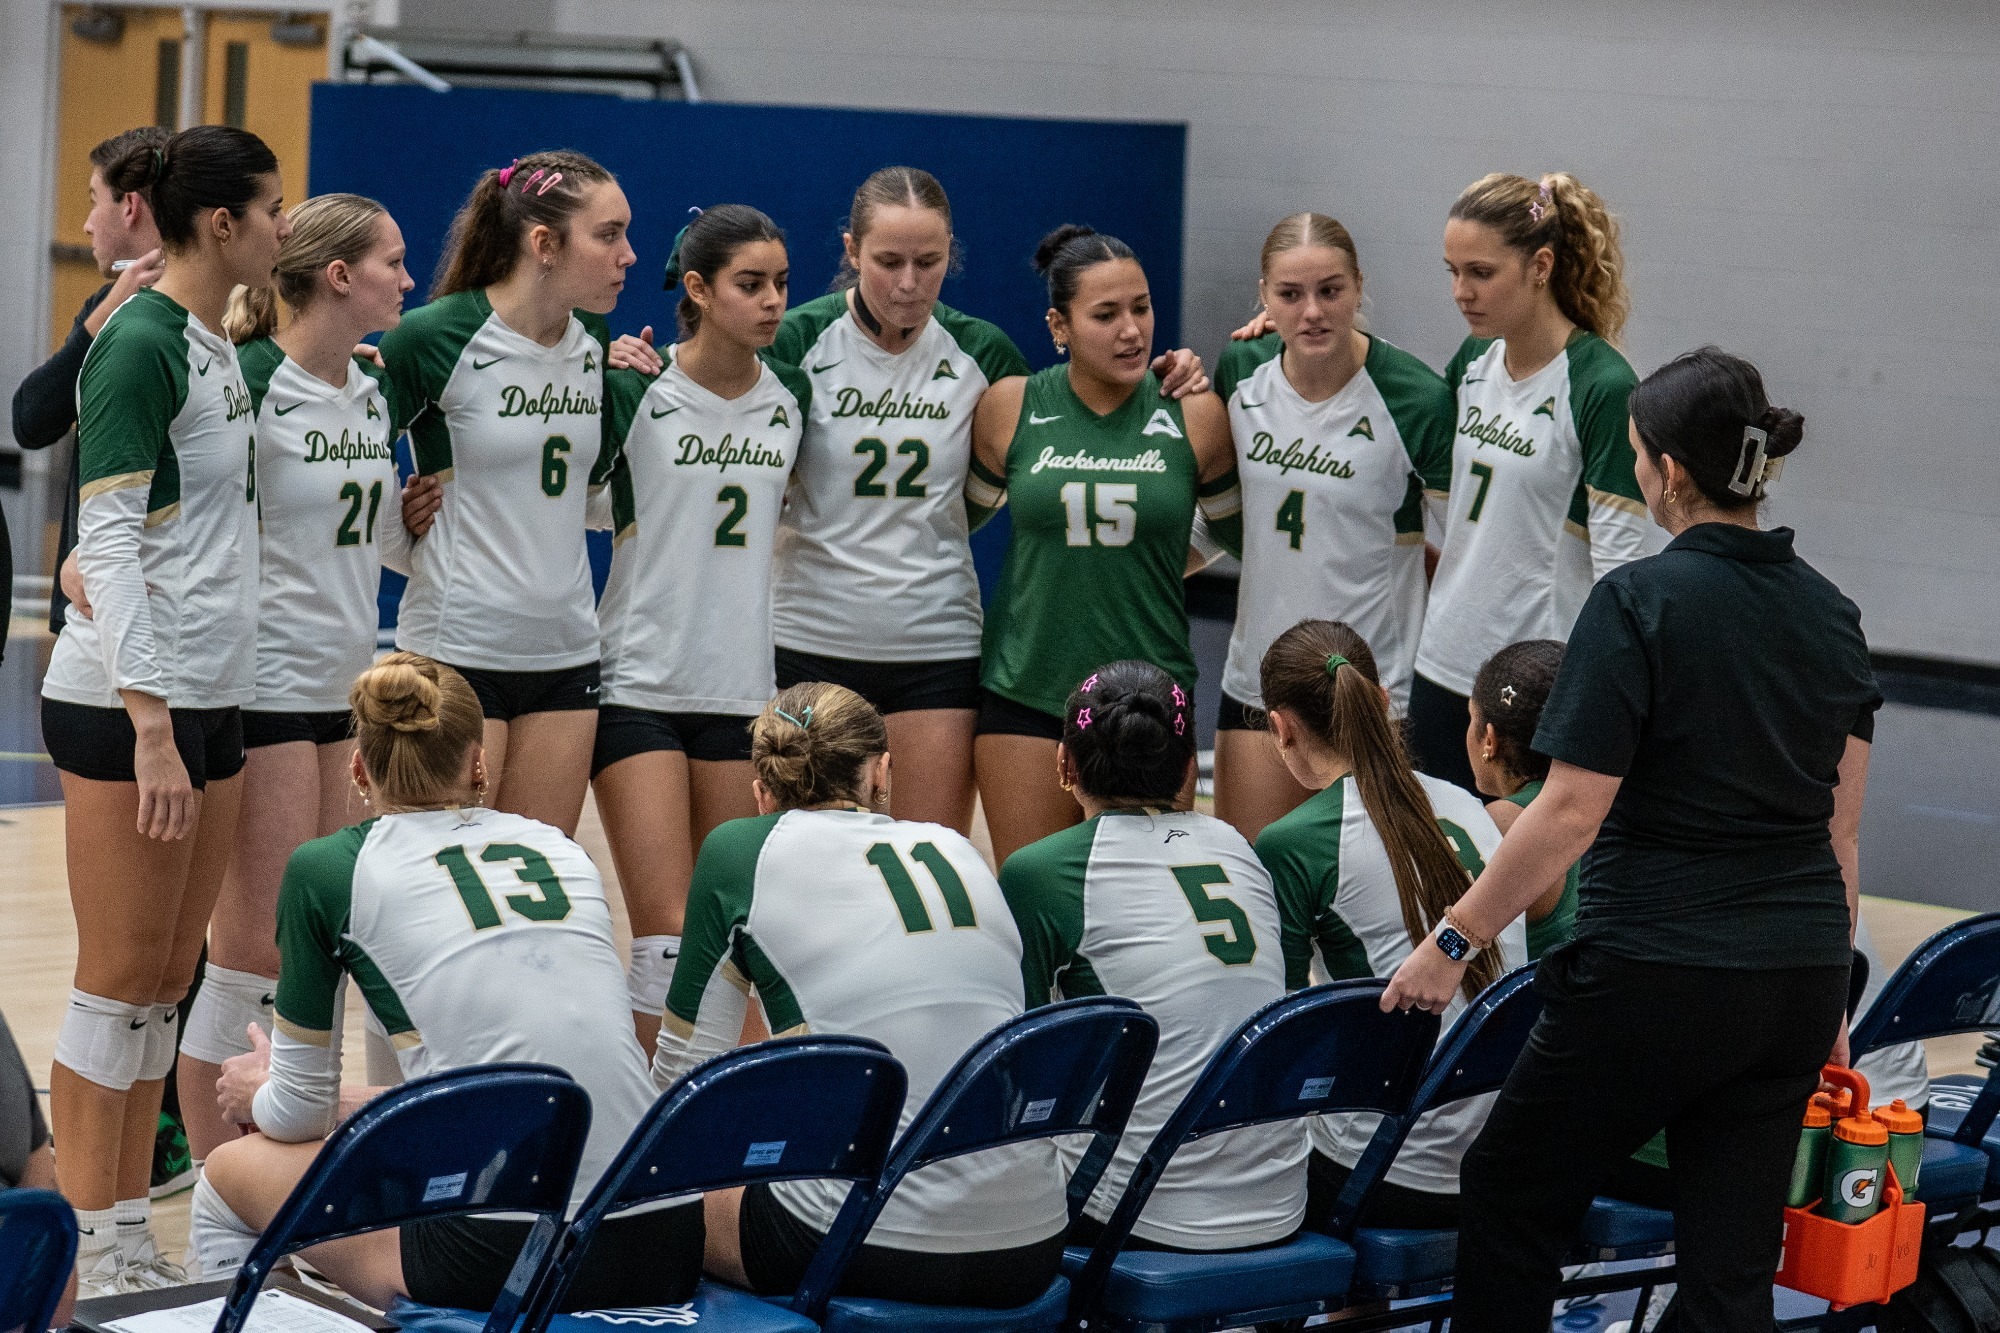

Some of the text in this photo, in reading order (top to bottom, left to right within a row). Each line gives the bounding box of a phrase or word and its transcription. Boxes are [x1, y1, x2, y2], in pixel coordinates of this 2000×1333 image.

[498, 382, 599, 424] Dolphins
[831, 387, 951, 426] Dolphins
[1458, 405, 1537, 458] Dolphins
[540, 433, 572, 498] 6
[674, 433, 786, 473] Dolphins
[853, 436, 931, 499] 22
[1030, 445, 1167, 475] Jacksonville
[1246, 431, 1356, 480] Dolphins
[334, 477, 383, 549] 21
[713, 483, 749, 549] 2
[1060, 482, 1138, 547] 15
[1274, 487, 1306, 552] 4
[1467, 458, 1494, 525] 7
[434, 842, 573, 934] 13
[863, 841, 980, 937] 11
[1168, 863, 1258, 967] 5
[1840, 1168, 1879, 1208] G
